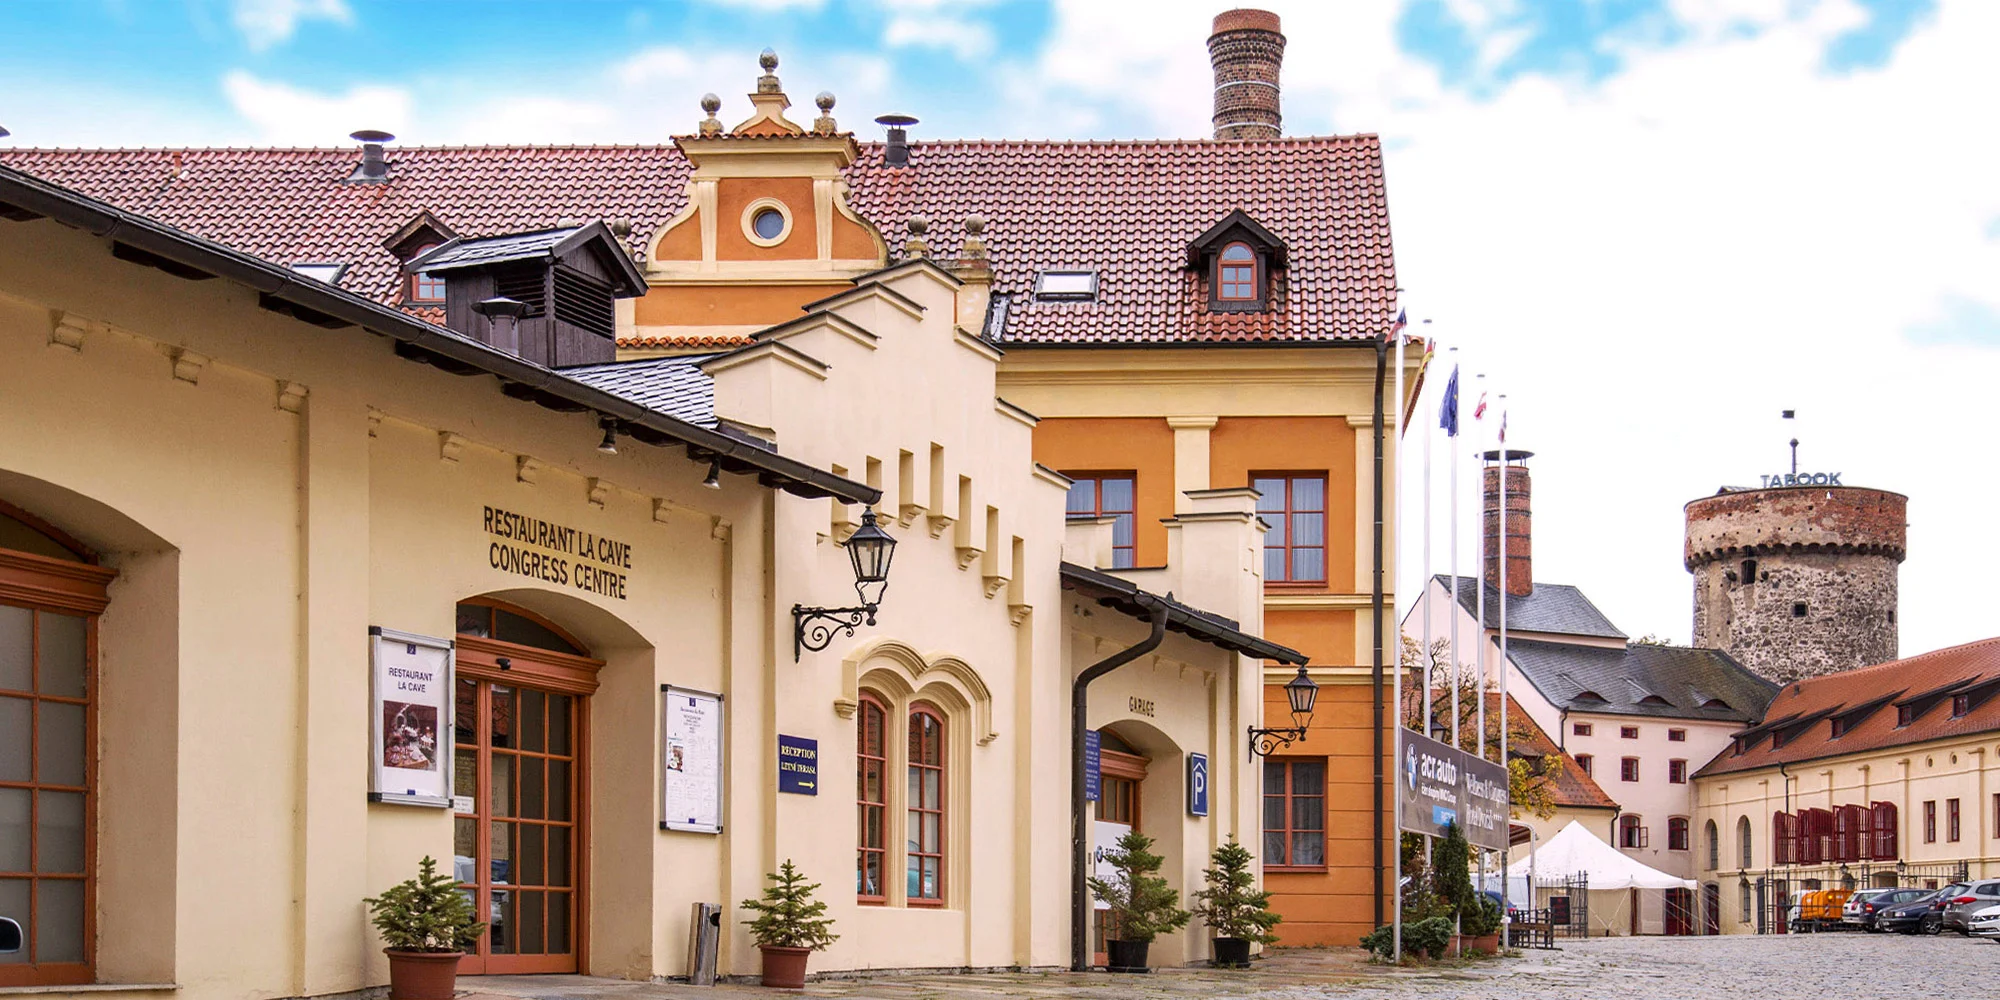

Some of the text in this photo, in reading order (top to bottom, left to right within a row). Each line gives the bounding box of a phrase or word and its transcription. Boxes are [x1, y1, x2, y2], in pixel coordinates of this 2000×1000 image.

[1760, 472, 1843, 488] TABOOK
[484, 505, 632, 569] RESTAURANT LA CAVE
[489, 542, 627, 600] CONGRESS CENTRE
[388, 667, 433, 682] RESTAURANT
[397, 681, 426, 693] LA CAVE
[1128, 696, 1155, 718] GARAGE
[781, 745, 816, 759] RECEPTION
[1421, 753, 1436, 779] acr
[1436, 758, 1457, 787] auto
[1195, 771, 1204, 805] P
